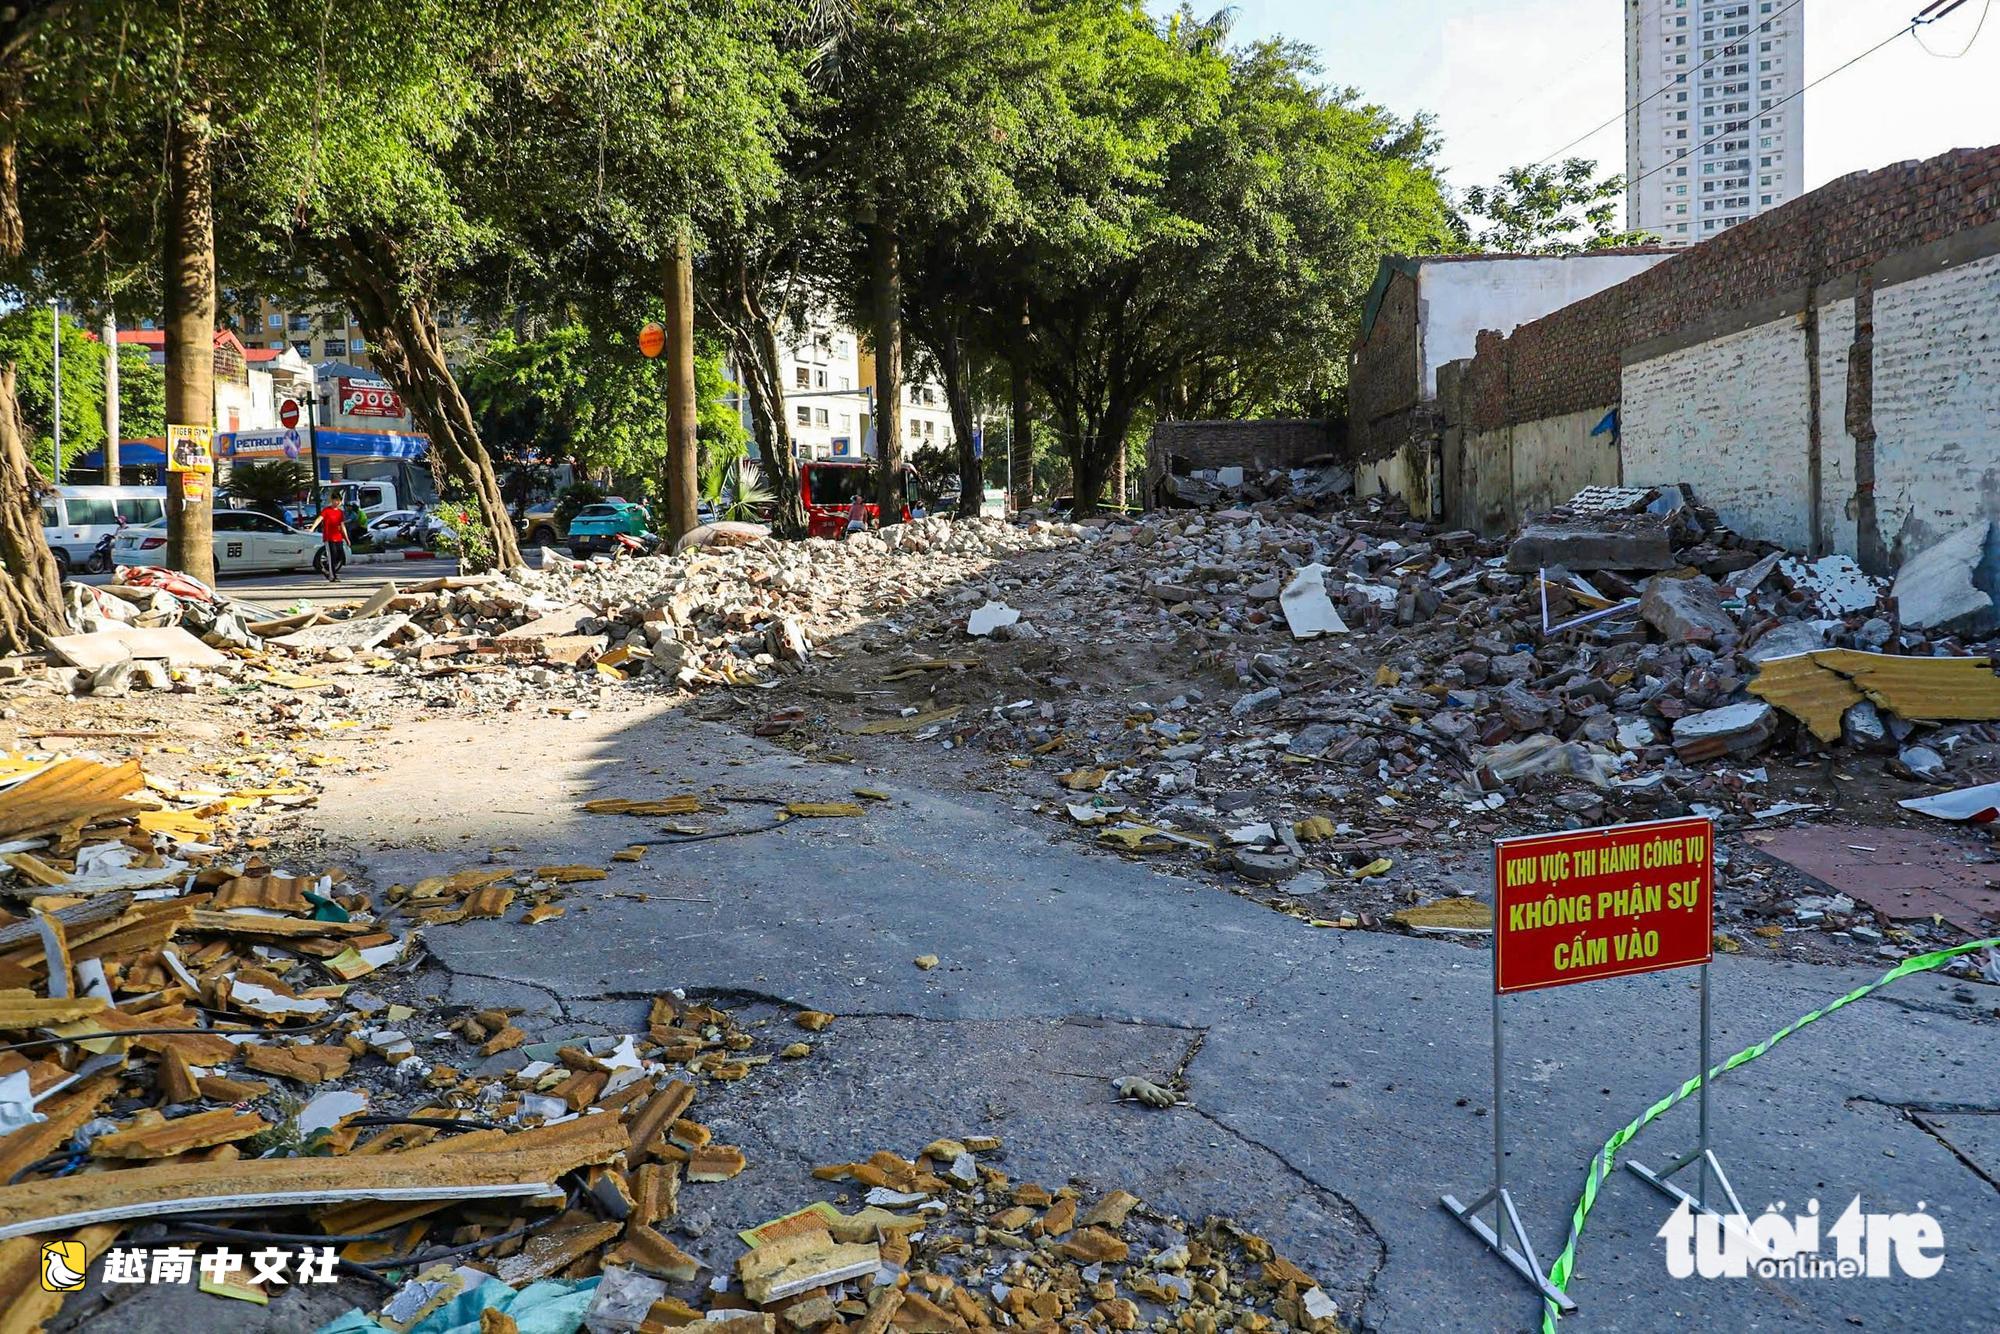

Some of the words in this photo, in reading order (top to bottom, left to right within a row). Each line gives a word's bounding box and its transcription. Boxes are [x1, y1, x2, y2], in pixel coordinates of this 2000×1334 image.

[173, 427, 192, 436] TIGER
[236, 436, 284, 448] PETROLI
[1506, 857, 1536, 887] KHU
[1540, 850, 1569, 887] VỰC
[1573, 848, 1596, 877] THI
[1600, 841, 1640, 874] HÀNH
[1643, 836, 1682, 868] CÔNG
[1685, 836, 1704, 868] VỤ
[1509, 894, 1592, 932] KHÔNG
[1597, 882, 1662, 920] PHẬN
[1667, 877, 1700, 912] SỰ
[1553, 930, 1608, 970] CẤM
[1613, 928, 1659, 961] VÀO
